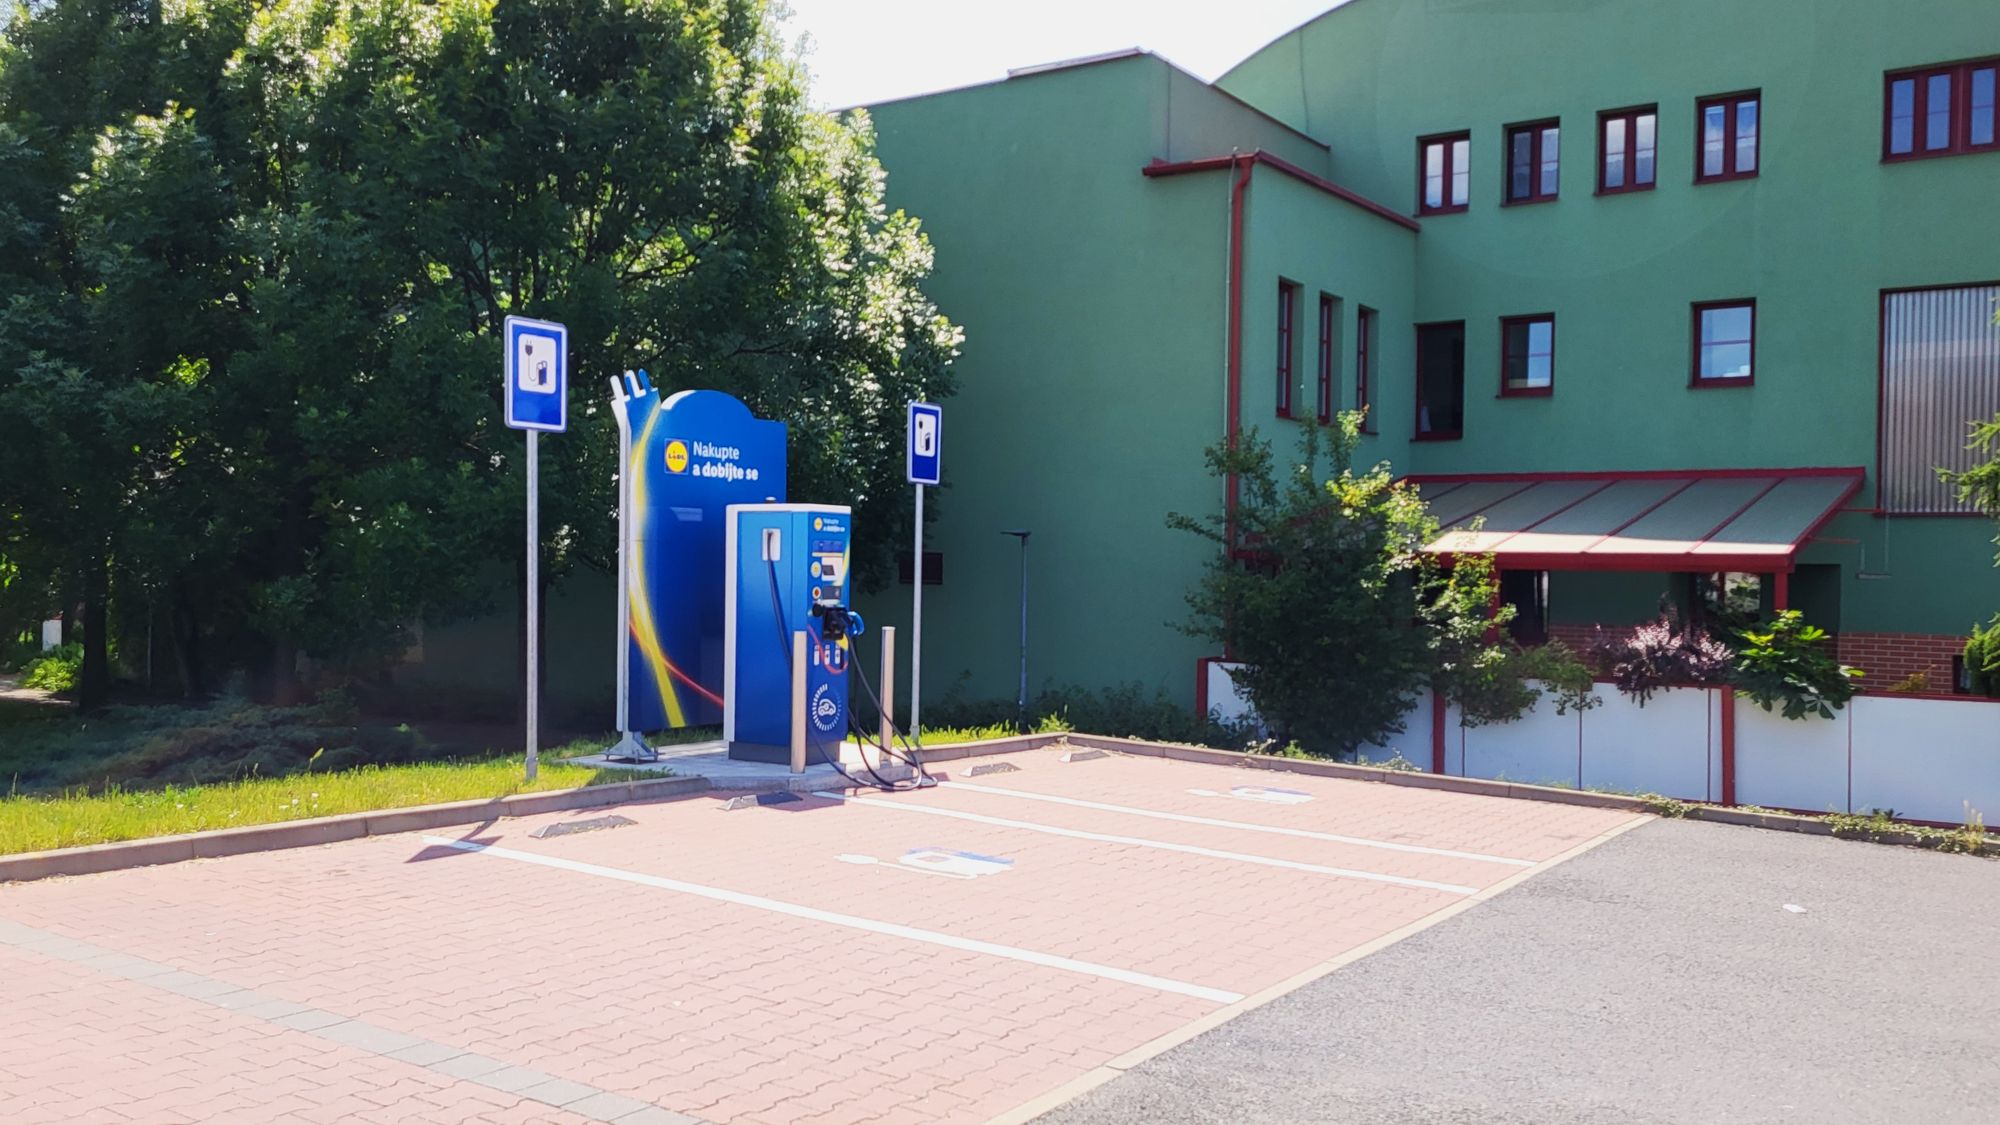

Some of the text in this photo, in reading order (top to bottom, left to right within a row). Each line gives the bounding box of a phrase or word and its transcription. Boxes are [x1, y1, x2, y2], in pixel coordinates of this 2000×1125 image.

[693, 441, 740, 461] Nakupte
[692, 461, 759, 482] a dobijte se
